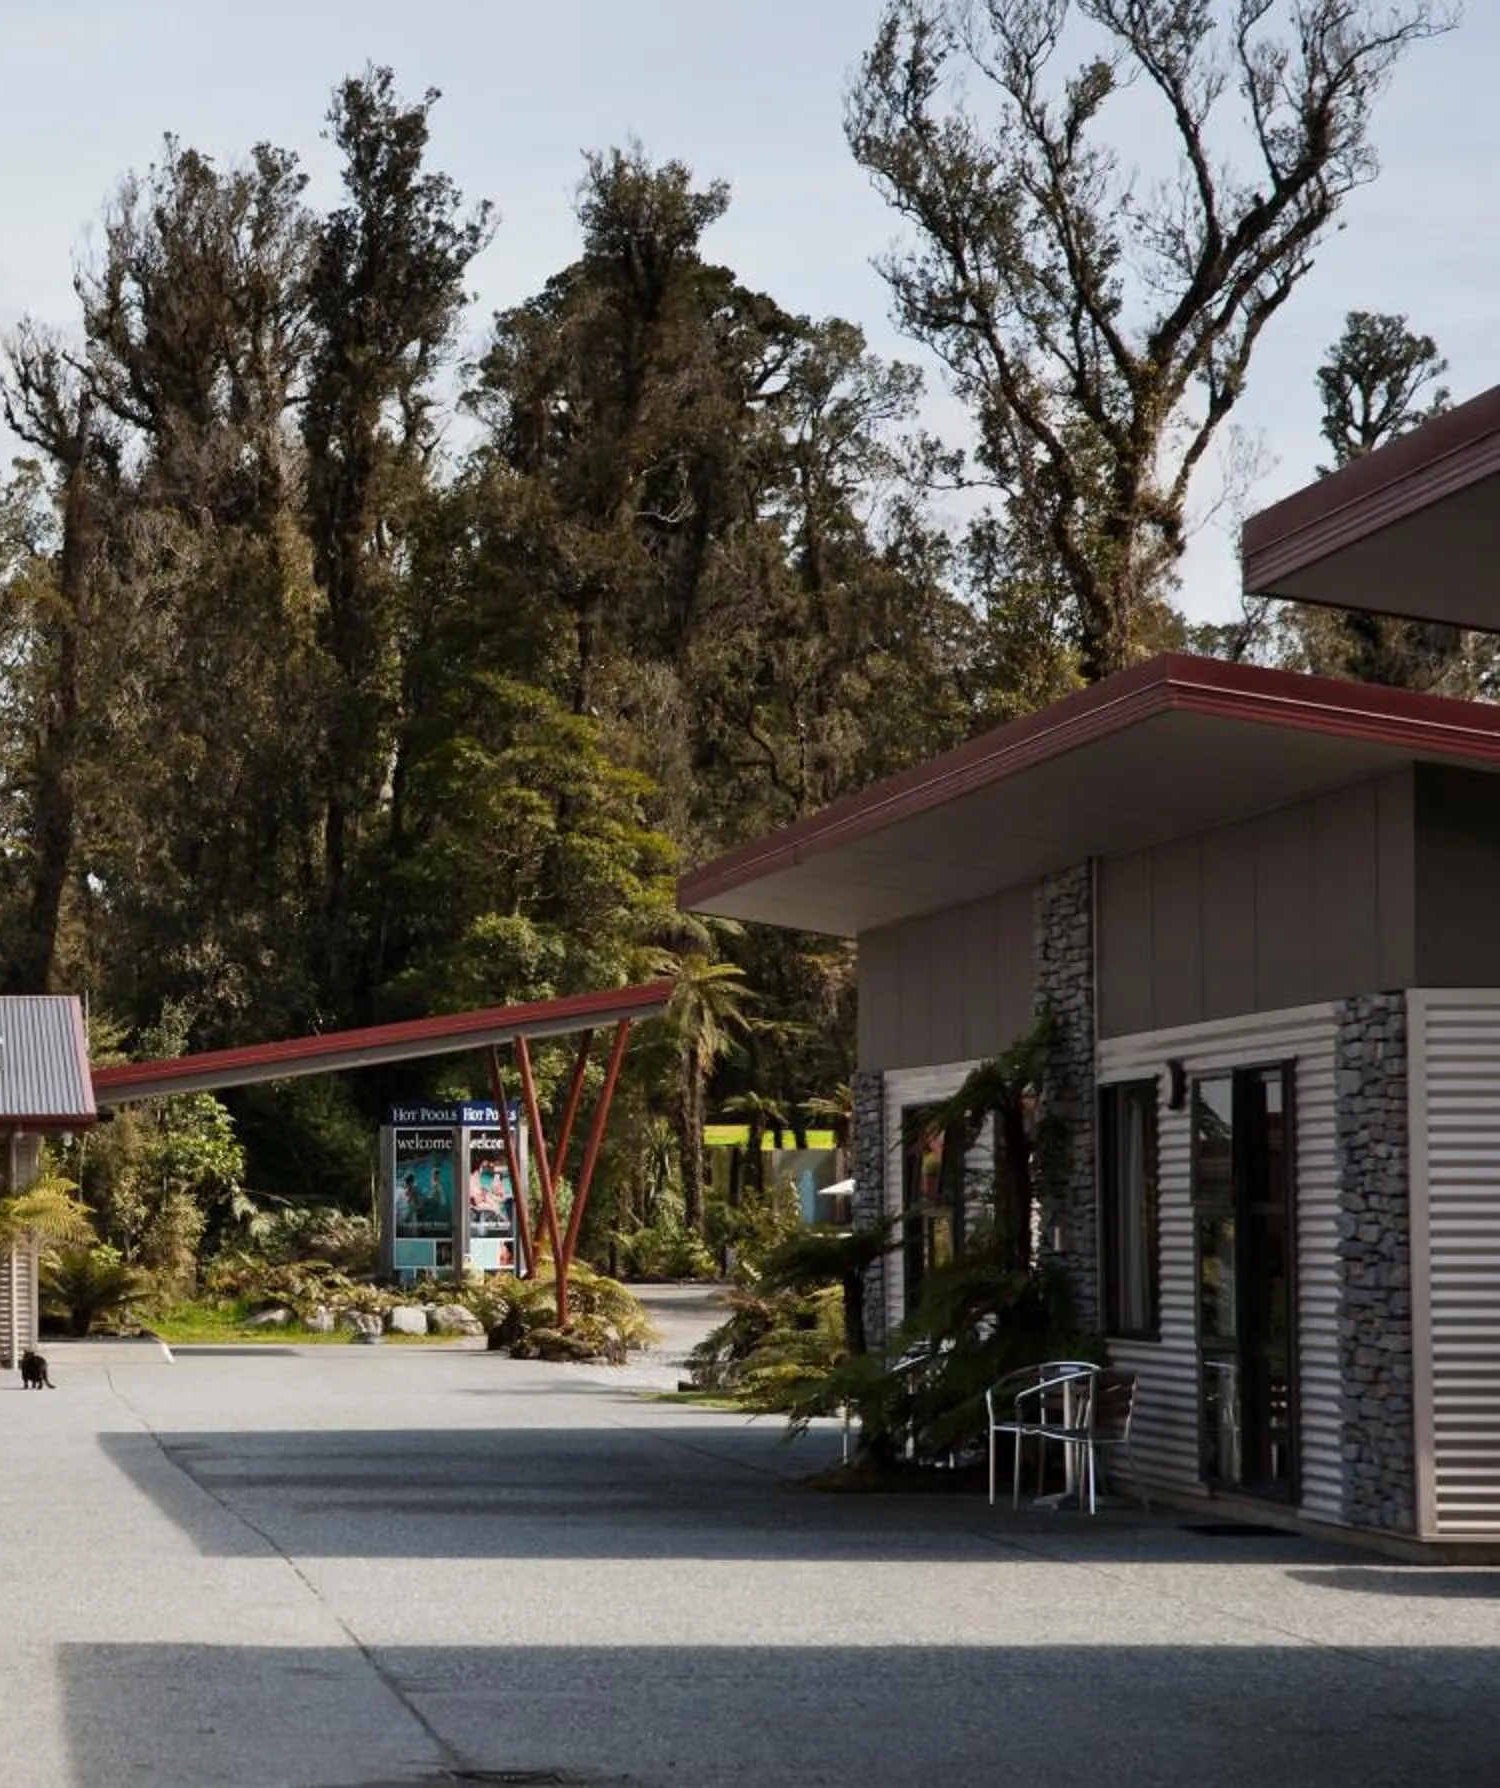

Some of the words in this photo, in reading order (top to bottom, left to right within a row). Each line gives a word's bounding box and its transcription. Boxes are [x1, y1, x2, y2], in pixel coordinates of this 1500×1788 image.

[393, 1107, 417, 1121] HOT
[420, 1107, 457, 1121] POOLS
[462, 1107, 484, 1121] HOT
[485, 1107, 517, 1121] POS
[397, 1132, 453, 1150] welcome
